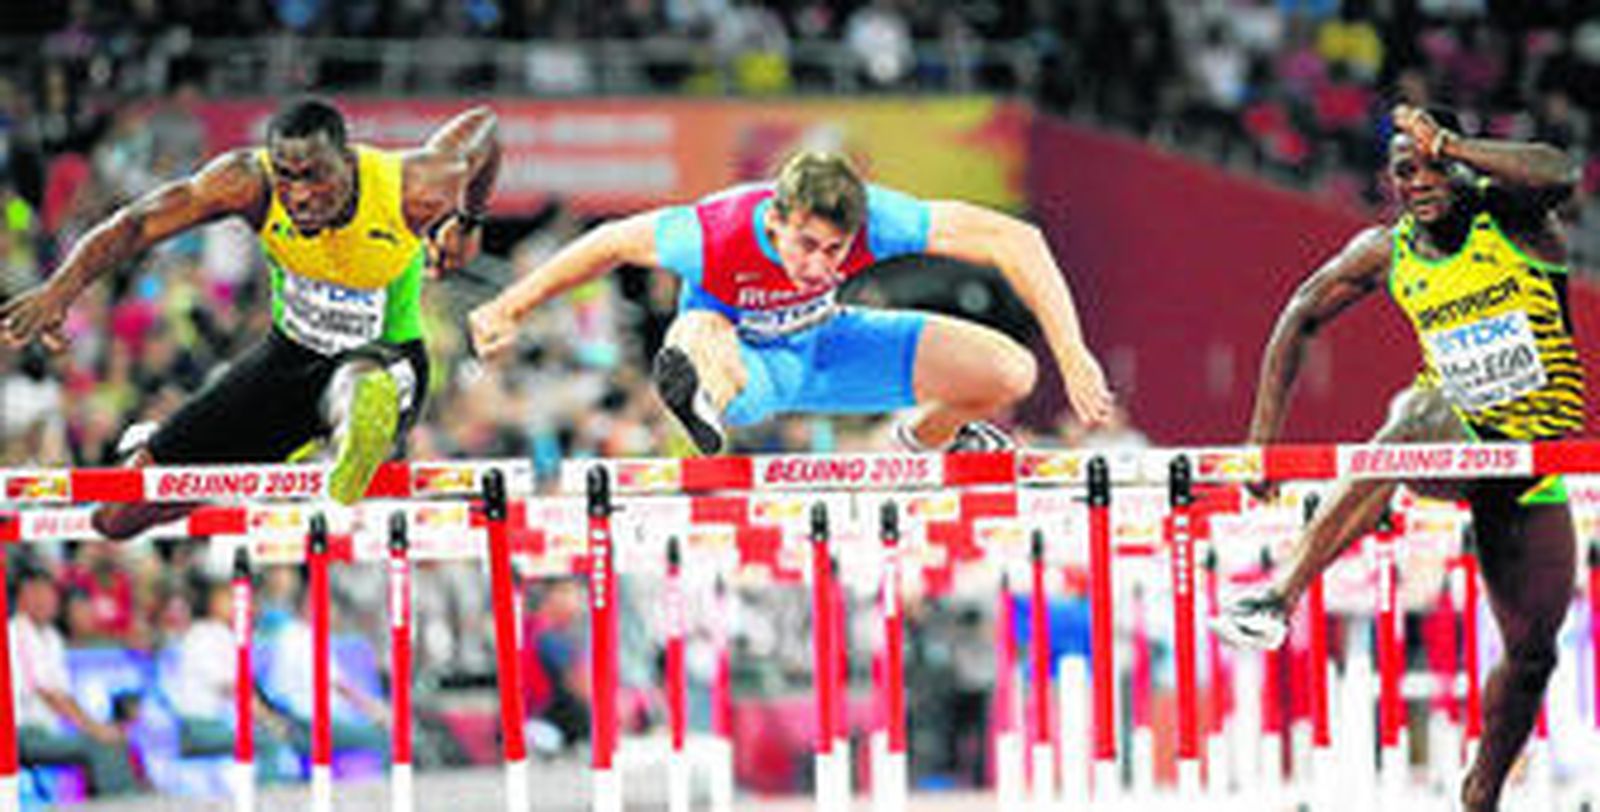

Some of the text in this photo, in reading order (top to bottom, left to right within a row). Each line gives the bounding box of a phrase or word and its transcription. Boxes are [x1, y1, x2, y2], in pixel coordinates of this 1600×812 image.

[1450, 314, 1520, 348] TDK
[763, 457, 930, 484] BEIJING 2015
[1350, 447, 1519, 473] BEIJING 2015
[157, 470, 323, 497] BEIJING 2015
